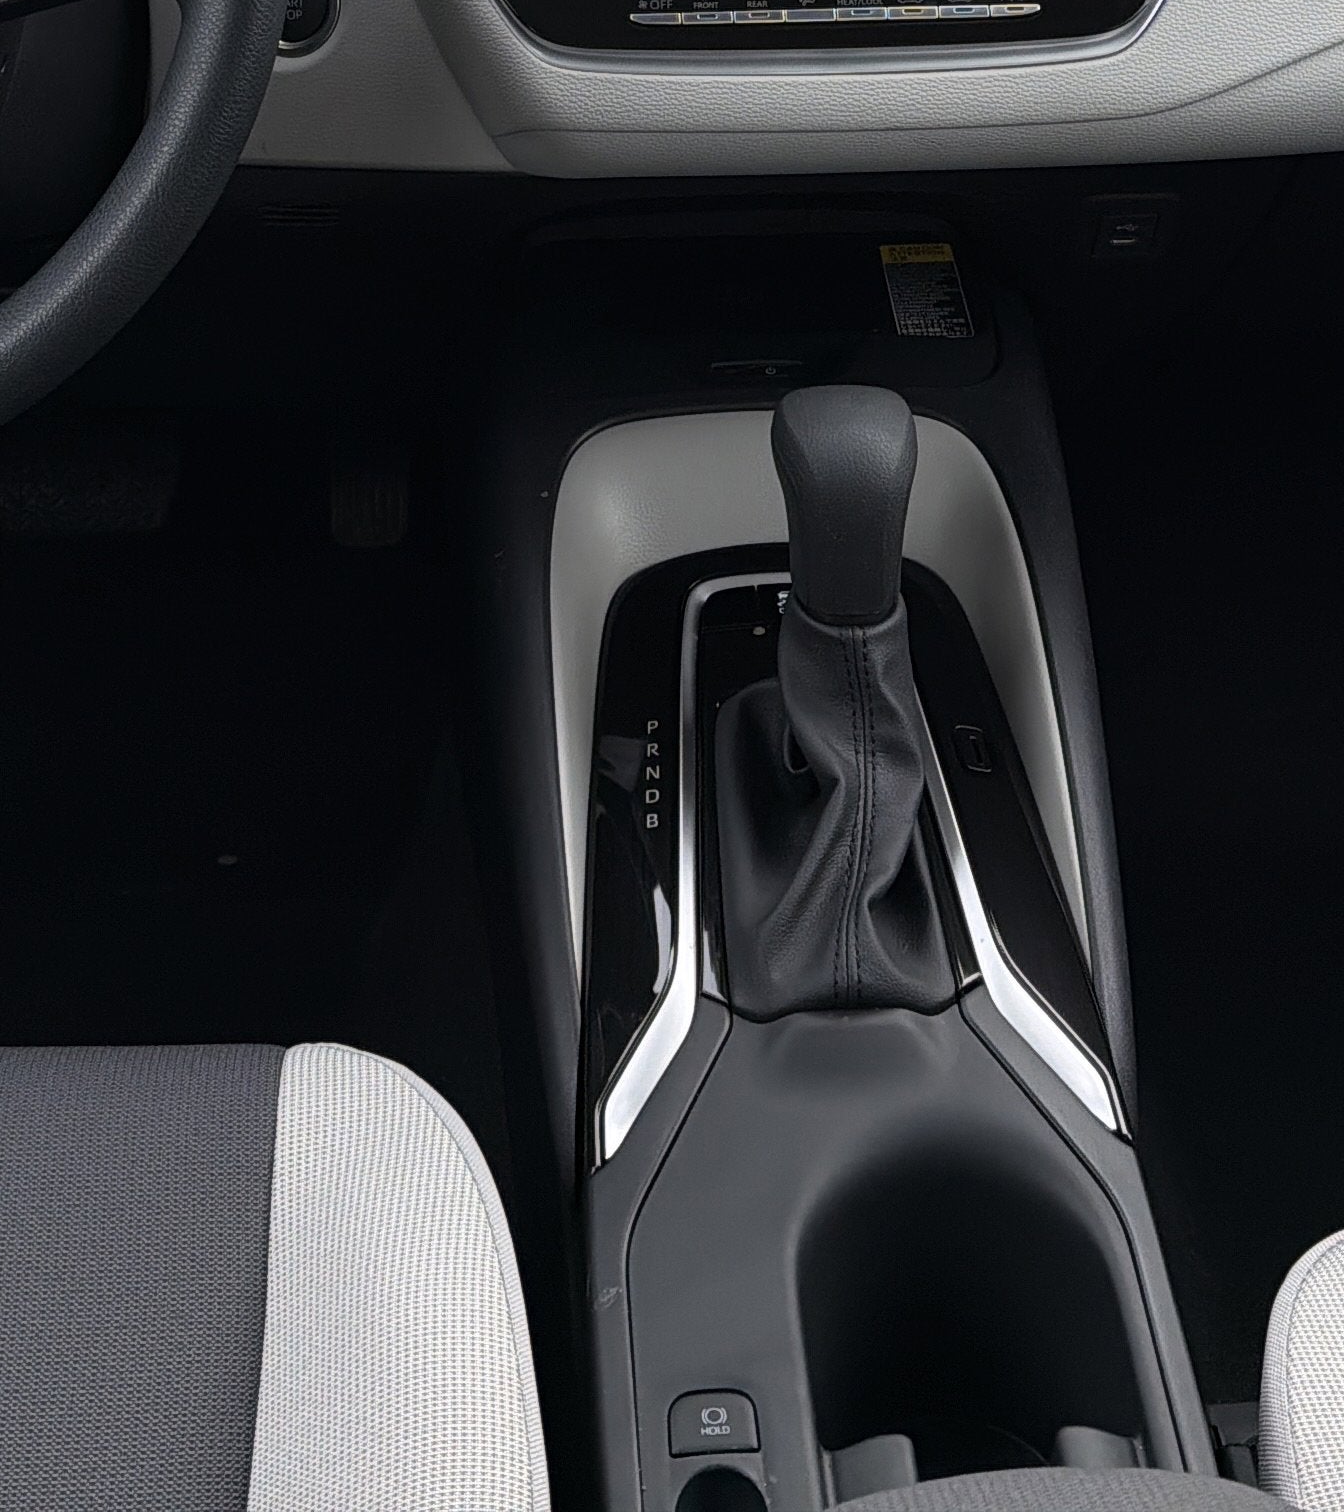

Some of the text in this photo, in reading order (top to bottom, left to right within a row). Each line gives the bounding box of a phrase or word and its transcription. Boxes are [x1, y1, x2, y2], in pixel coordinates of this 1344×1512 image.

[649, 0, 674, 10] OFF
[693, 1, 719, 10] FRONT
[746, 0, 769, 9] REAR
[647, 720, 659, 735] P
[646, 742, 660, 758] R
[646, 765, 660, 781] N
[645, 789, 660, 804] D
[646, 813, 659, 829] B
[700, 1425, 731, 1436] HOLD
